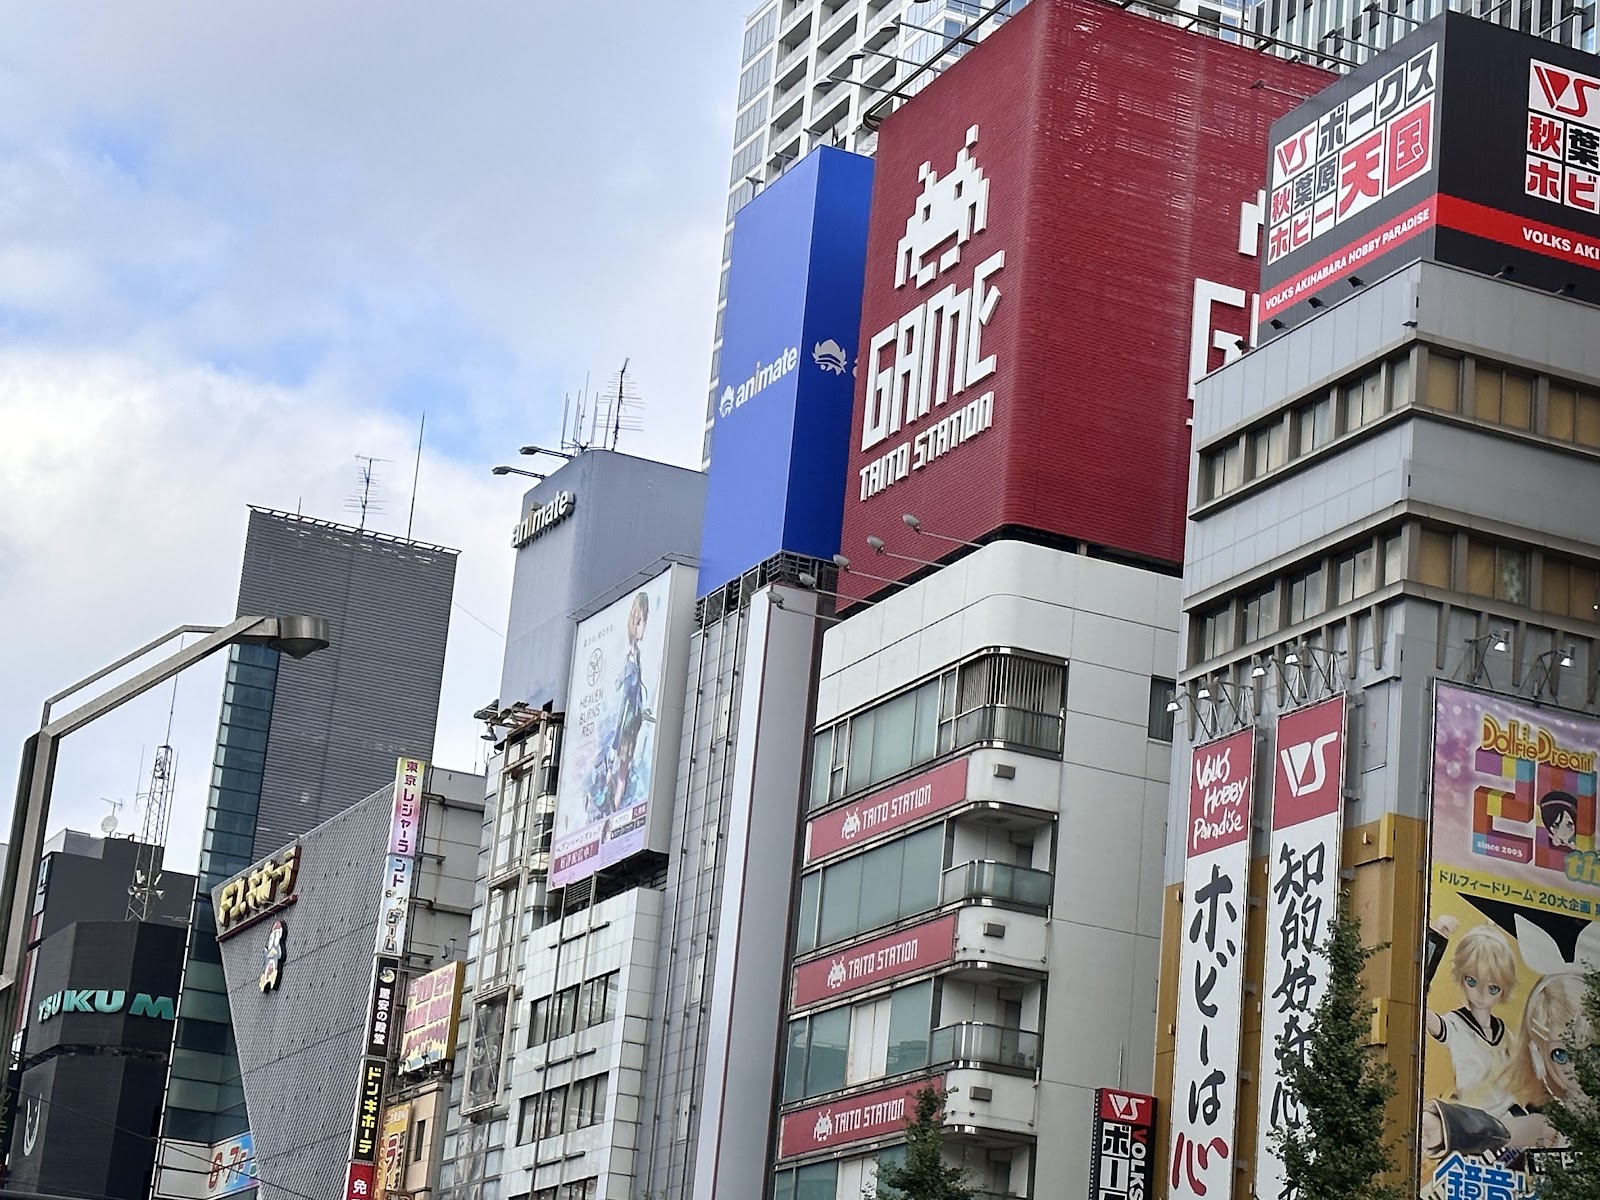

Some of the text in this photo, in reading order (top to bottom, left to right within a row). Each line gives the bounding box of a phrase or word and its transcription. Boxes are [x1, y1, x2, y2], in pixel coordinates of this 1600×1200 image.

[1319, 48, 1434, 155] ボークス
[1271, 159, 1337, 223] 秋葉原
[1528, 162, 1595, 210] ホビ
[1269, 207, 1334, 260] ホビー
[1522, 227, 1572, 251] VOLKS
[1265, 208, 1430, 310] VOLKS AKIHABARA HOBBY PARADISE
[861, 250, 1005, 452] GAME
[735, 347, 798, 408] animate
[859, 391, 995, 502] TAITO STATION
[511, 490, 573, 547] animate
[579, 687, 604, 709] HEAVEN
[579, 703, 601, 725] BURNS
[581, 722, 595, 738] RED
[393, 760, 419, 888] 東京レジャーランド
[862, 784, 932, 830] TAITO STATION
[1193, 808, 1245, 850] Paradise
[1477, 840, 1524, 858] since 2003
[384, 909, 404, 954] ゲーム
[848, 938, 919, 980] TAITO STATION
[1171, 863, 1238, 1197] ホビーは心
[834, 1098, 905, 1134] TAITO STATION
[1101, 1124, 1131, 1200] ボー
[1129, 1128, 1148, 1200] VOLKS
[351, 1178, 368, 1200] 免
